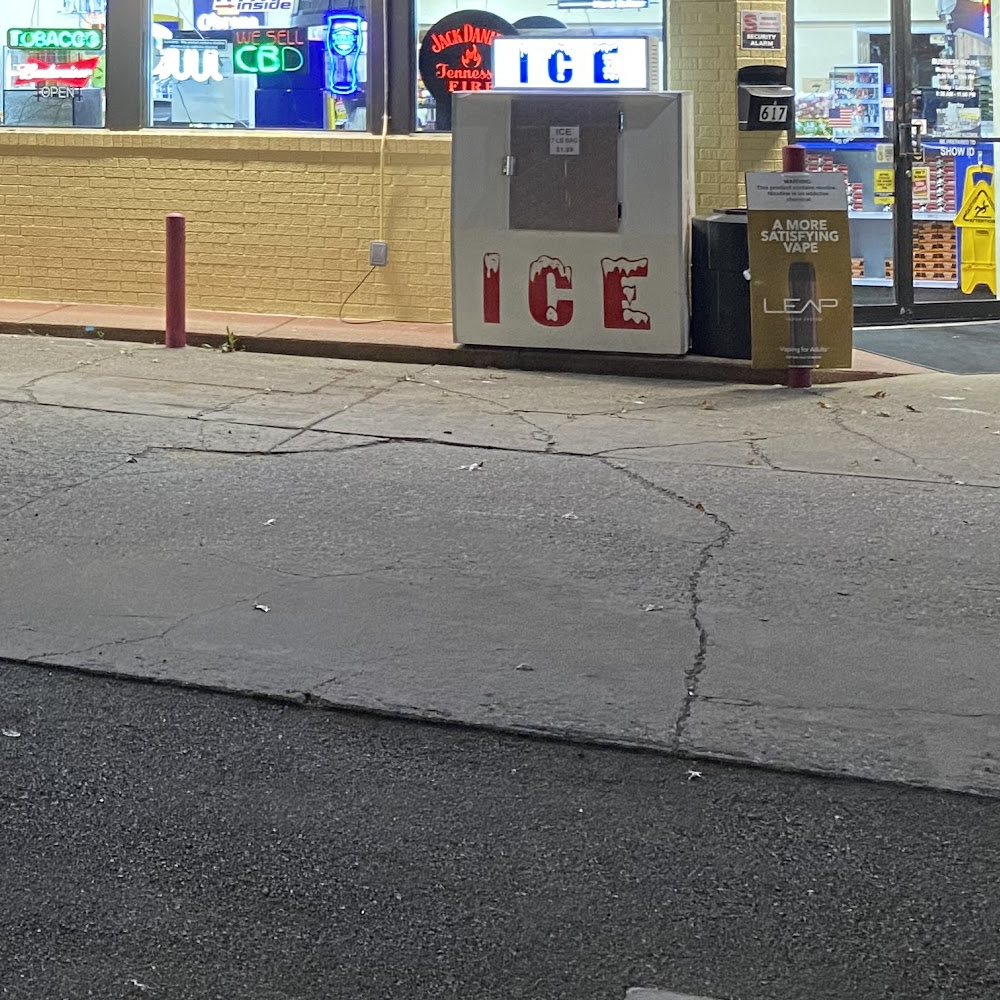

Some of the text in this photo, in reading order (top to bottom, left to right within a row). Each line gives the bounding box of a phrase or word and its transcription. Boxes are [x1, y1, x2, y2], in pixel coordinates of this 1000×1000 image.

[237, 0, 292, 10] inside
[9, 29, 101, 49] TOBACCO
[236, 30, 261, 46] WE
[266, 29, 304, 46] SELL
[430, 28, 464, 54] JACK
[235, 45, 304, 73] CBD
[519, 42, 620, 84] ICE
[40, 86, 75, 98] OPEN
[761, 106, 786, 121] 617
[555, 128, 572, 136] ICE
[940, 146, 975, 157] SHOW ID
[772, 219, 828, 231] A MORE
[760, 230, 839, 242] SATISFYING
[783, 242, 819, 253] VAPE
[482, 252, 652, 331] ICE
[763, 298, 839, 314] LEAP
